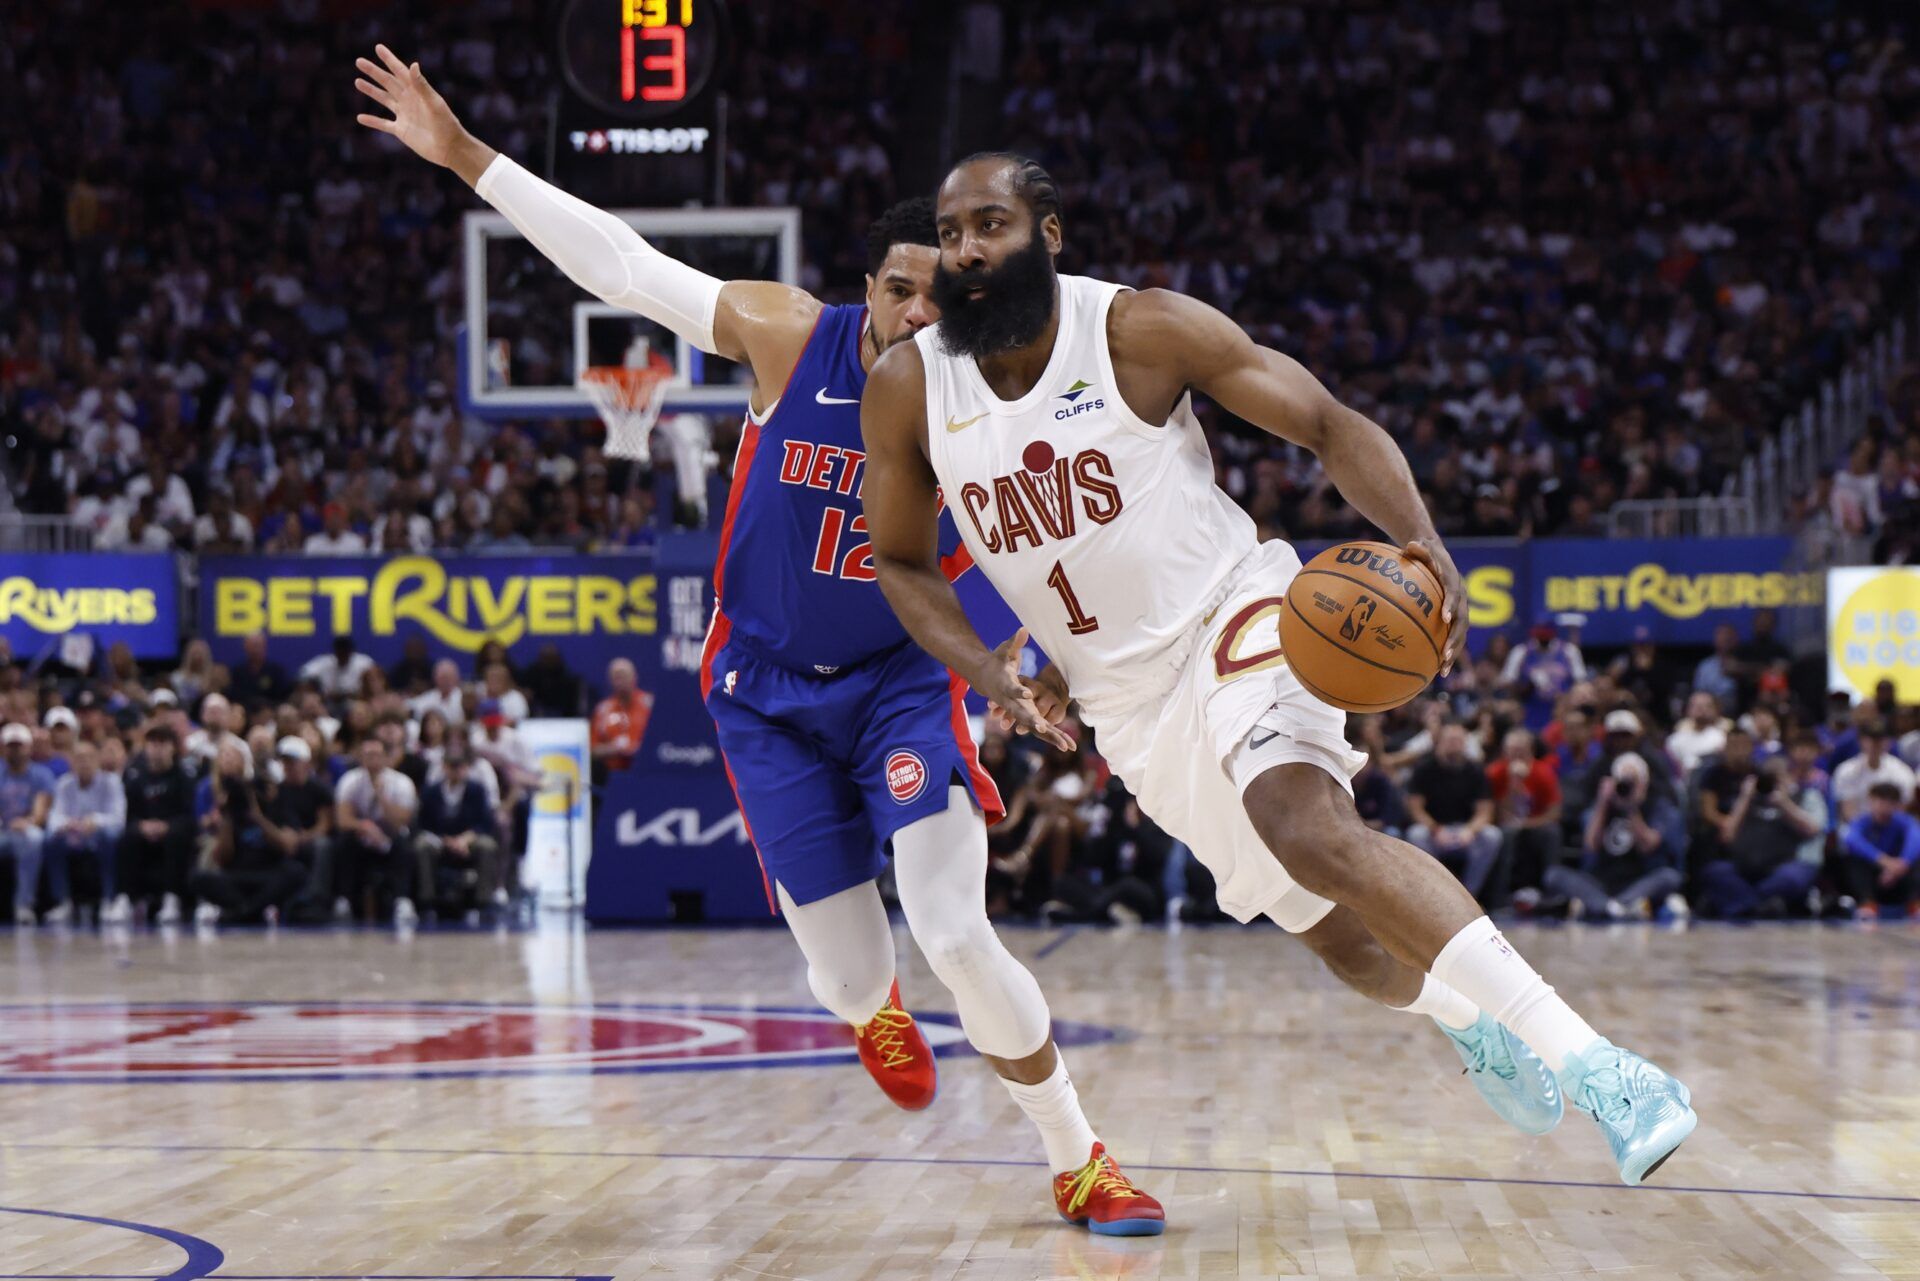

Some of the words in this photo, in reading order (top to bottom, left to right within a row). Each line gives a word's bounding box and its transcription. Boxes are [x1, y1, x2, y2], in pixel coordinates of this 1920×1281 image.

[621, 26, 686, 101] 13
[607, 128, 709, 154] TISSOT
[1054, 398, 1105, 421] CLIFFS
[779, 439, 868, 500] DET
[960, 448, 1124, 554] CAVS
[1046, 559, 1100, 635] 1
[1335, 547, 1434, 618] Wilson
[658, 741, 716, 766] Google
